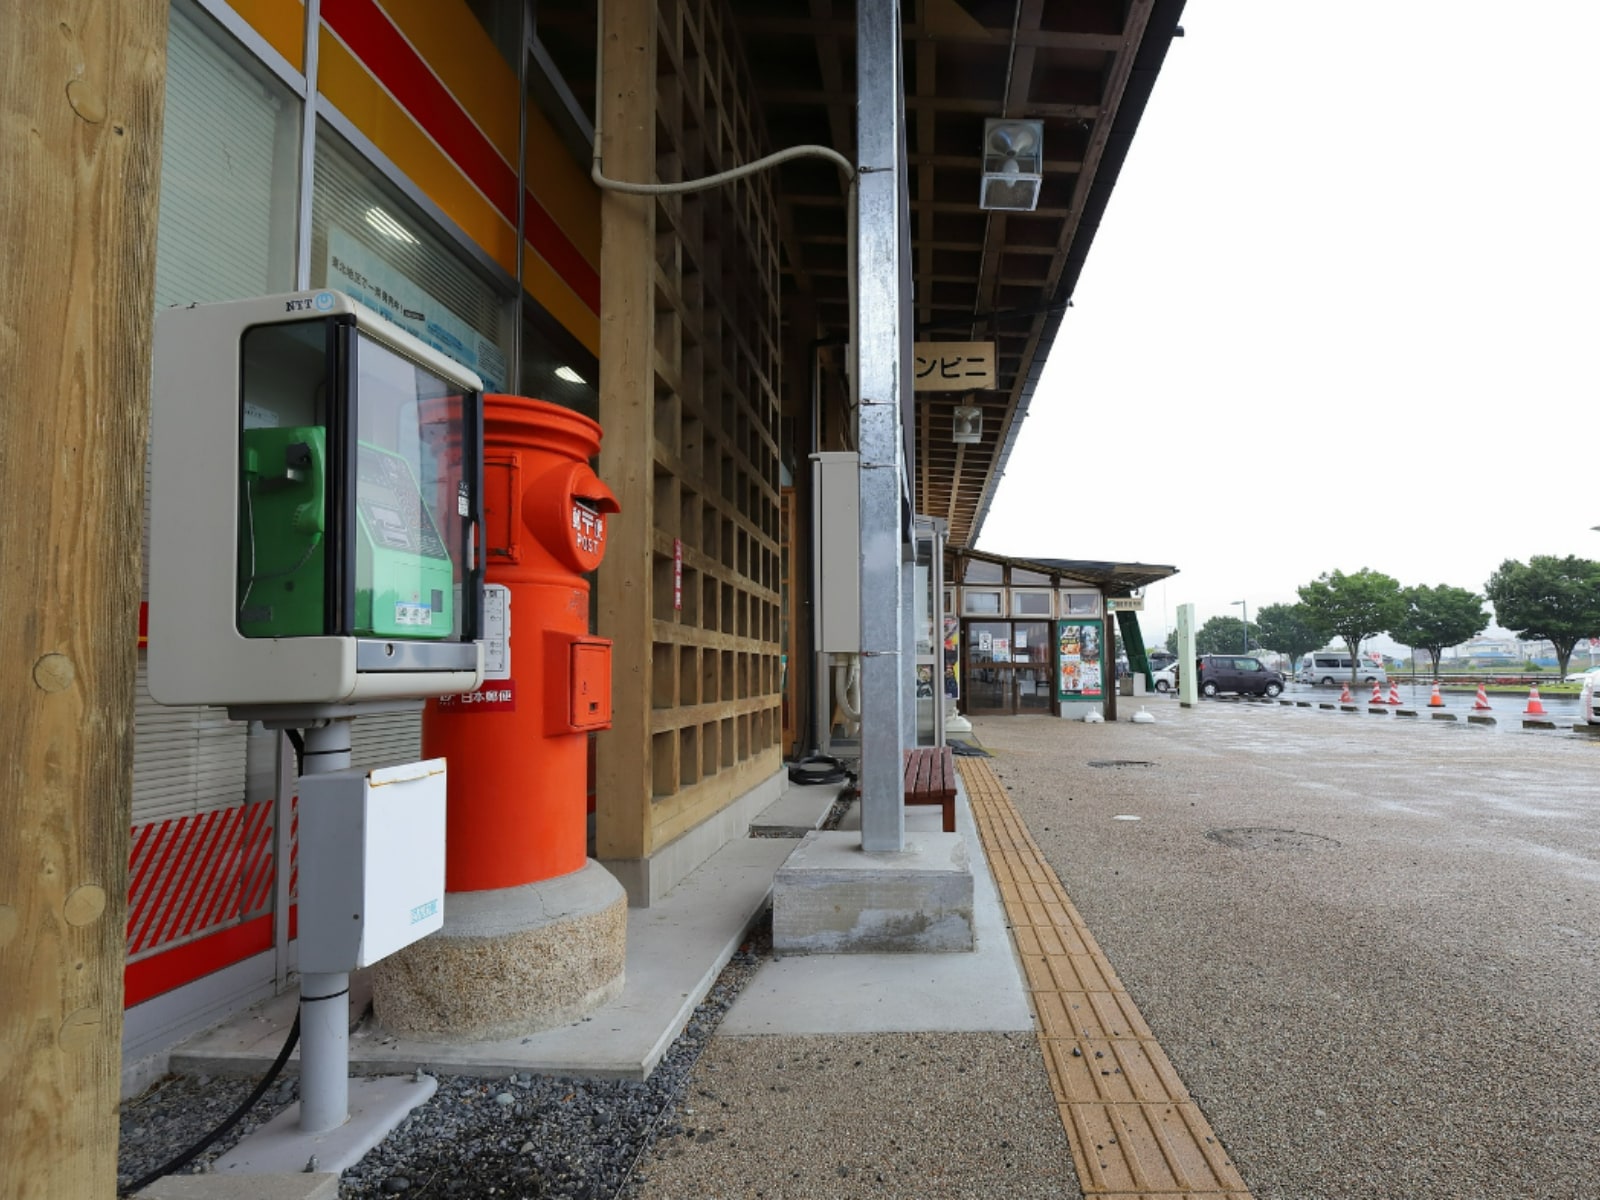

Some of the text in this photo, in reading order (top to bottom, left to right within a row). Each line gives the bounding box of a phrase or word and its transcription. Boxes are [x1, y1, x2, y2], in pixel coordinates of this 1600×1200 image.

[286, 298, 312, 312] NTT
[916, 356, 986, 378] ンビニ
[577, 532, 599, 555] POST
[461, 688, 512, 703] 日本郵便
